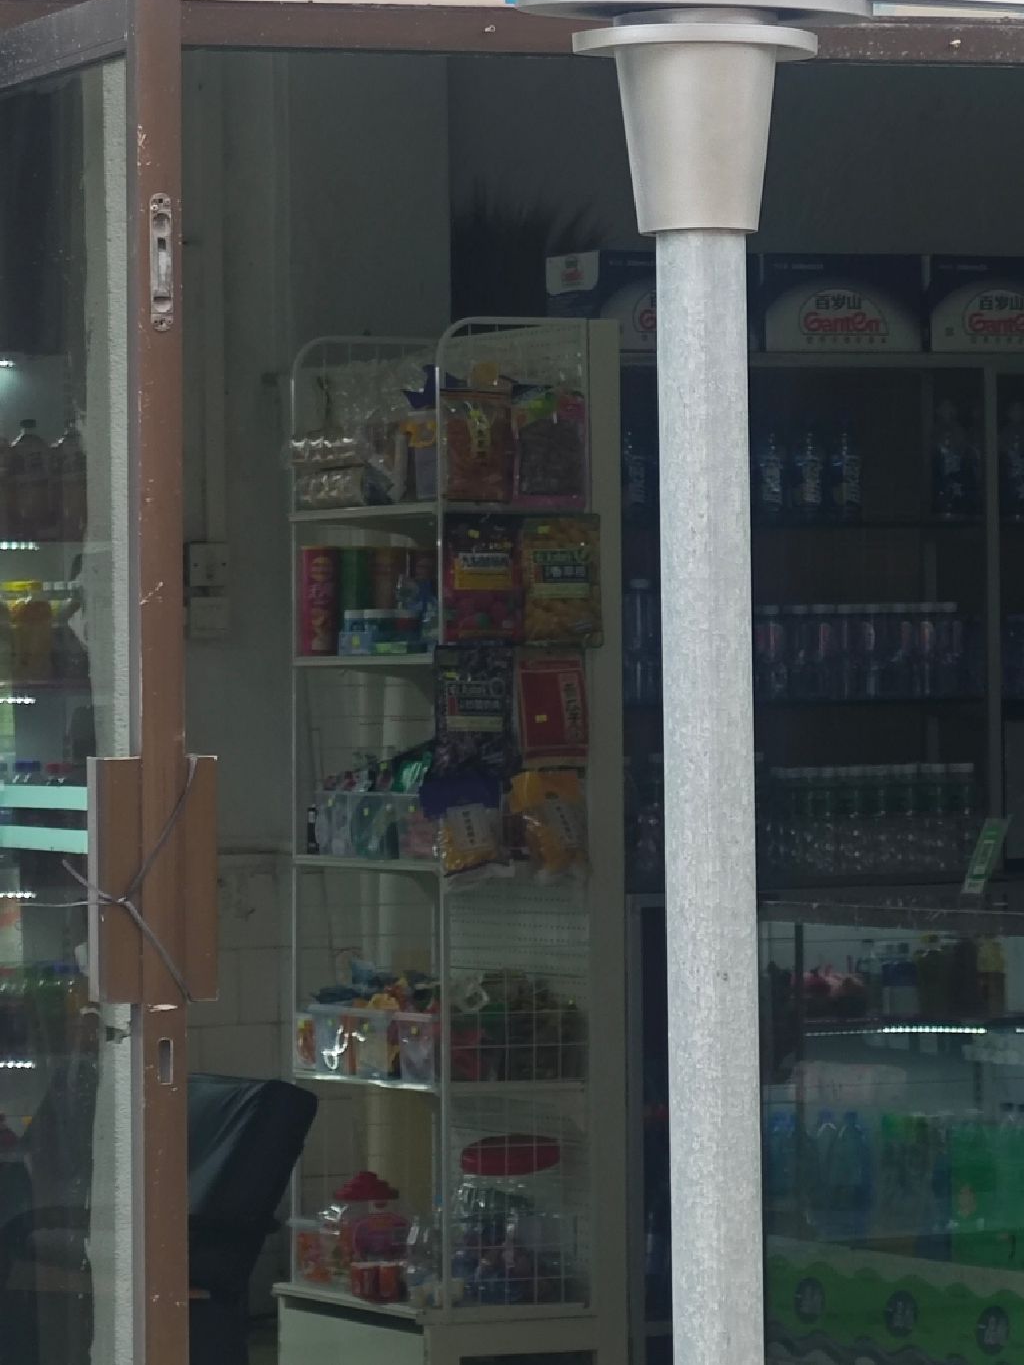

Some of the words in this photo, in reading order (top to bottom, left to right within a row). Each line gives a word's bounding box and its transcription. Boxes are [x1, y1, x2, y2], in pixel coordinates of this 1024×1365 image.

[815, 293, 862, 310] 百岁山
[979, 295, 1024, 310] 百岁山
